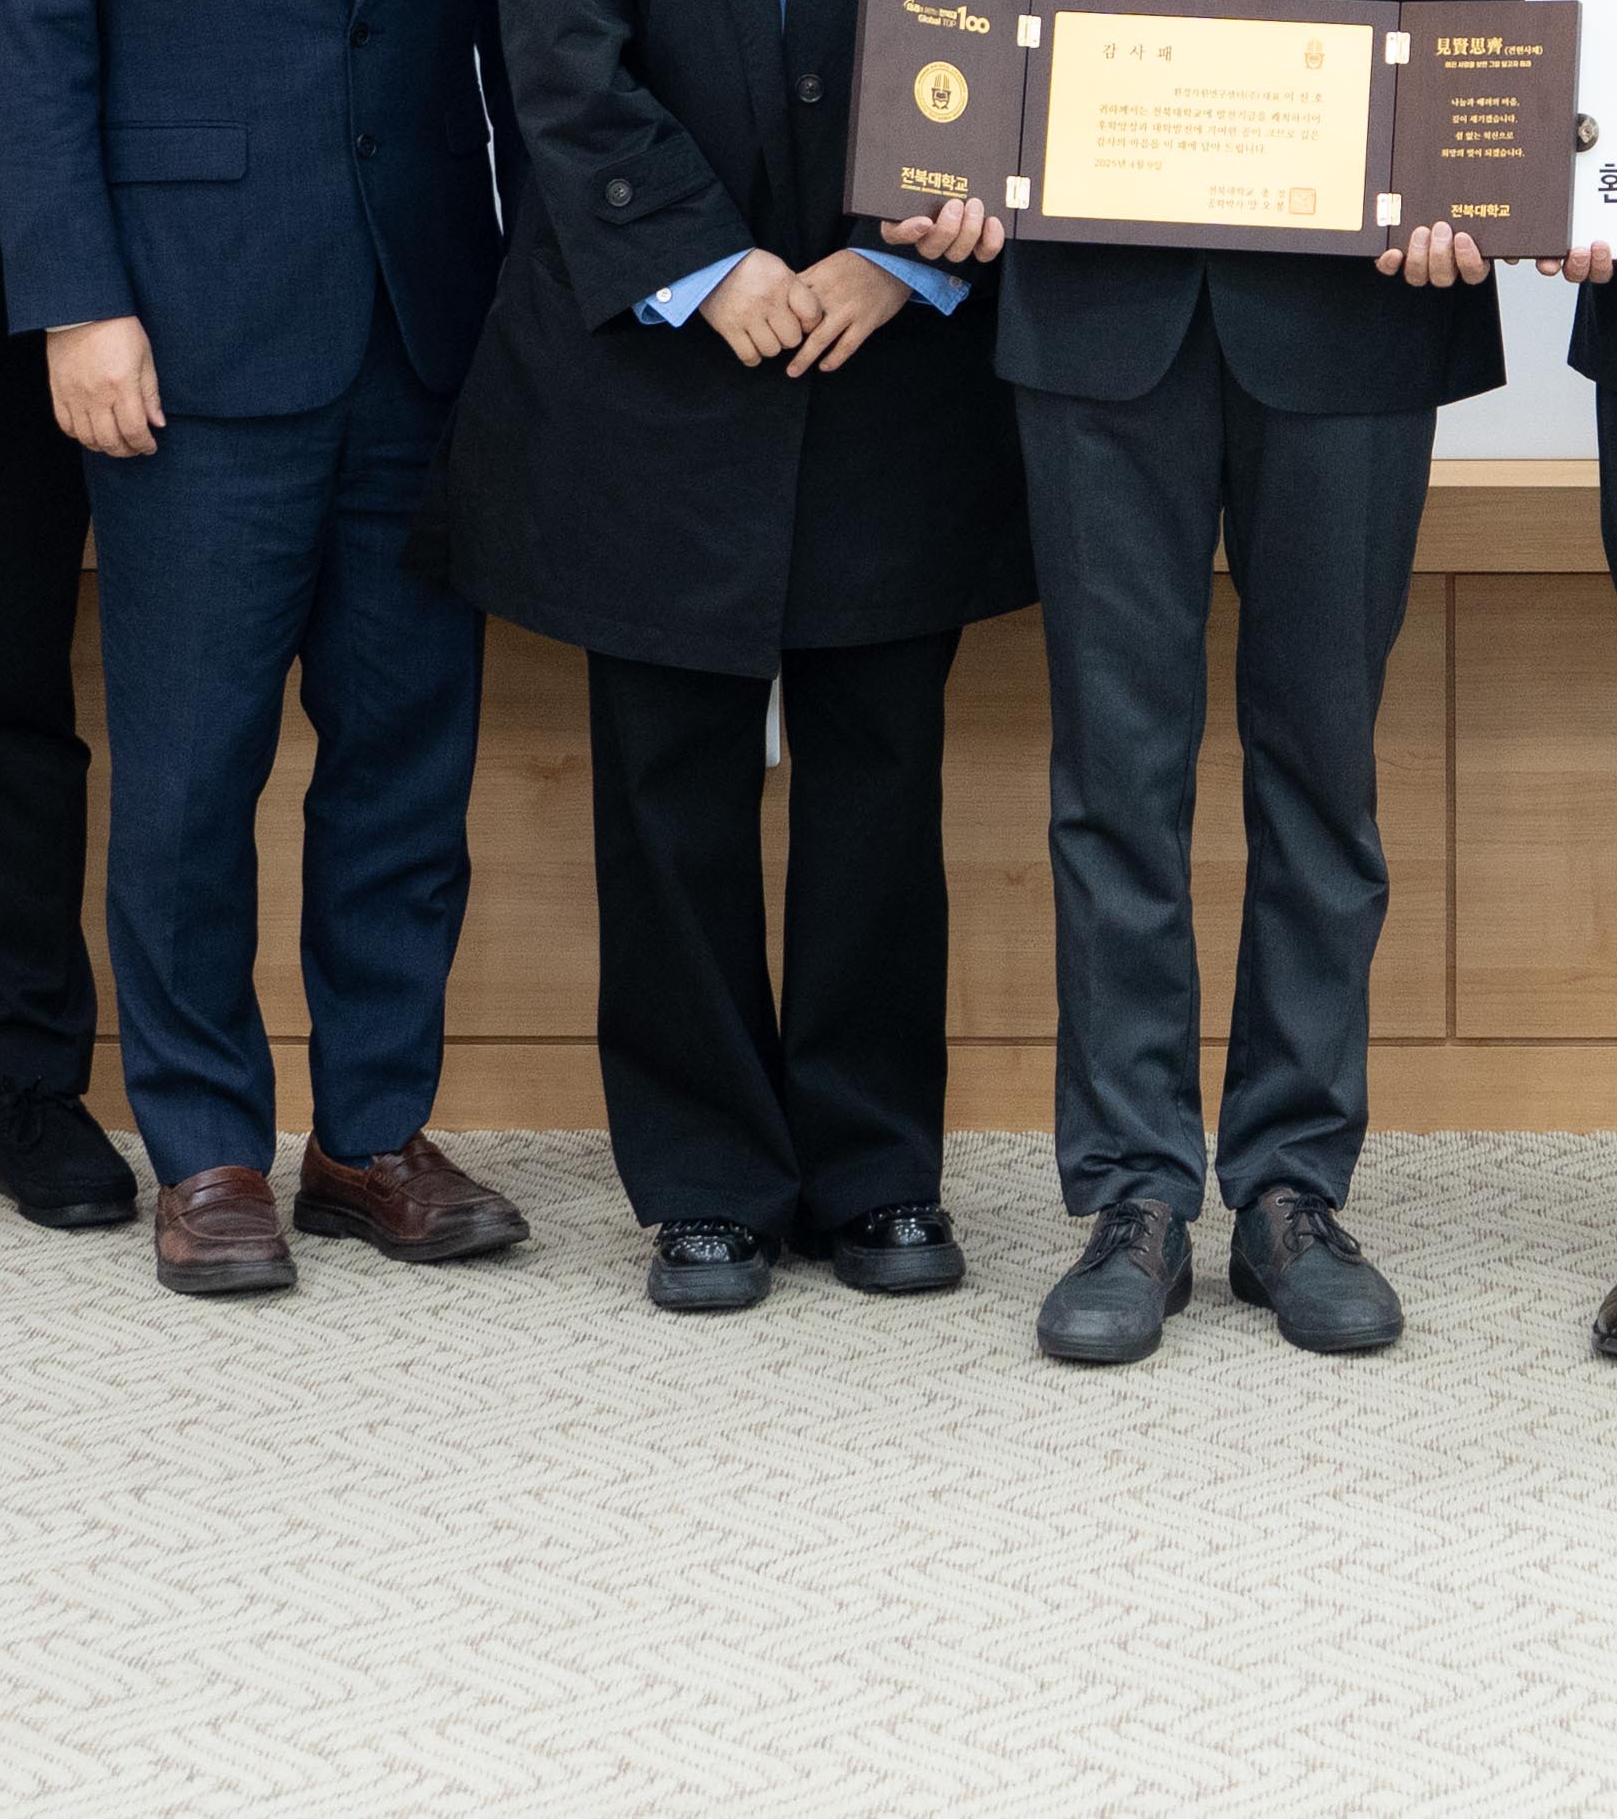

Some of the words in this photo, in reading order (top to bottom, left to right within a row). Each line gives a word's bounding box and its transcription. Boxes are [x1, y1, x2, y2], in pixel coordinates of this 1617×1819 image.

[957, 6, 991, 34] 100
[1435, 36, 1504, 56] 見賢思齊
[900, 166, 969, 192] 전북대학교
[1450, 203, 1512, 218] 전북대학교
